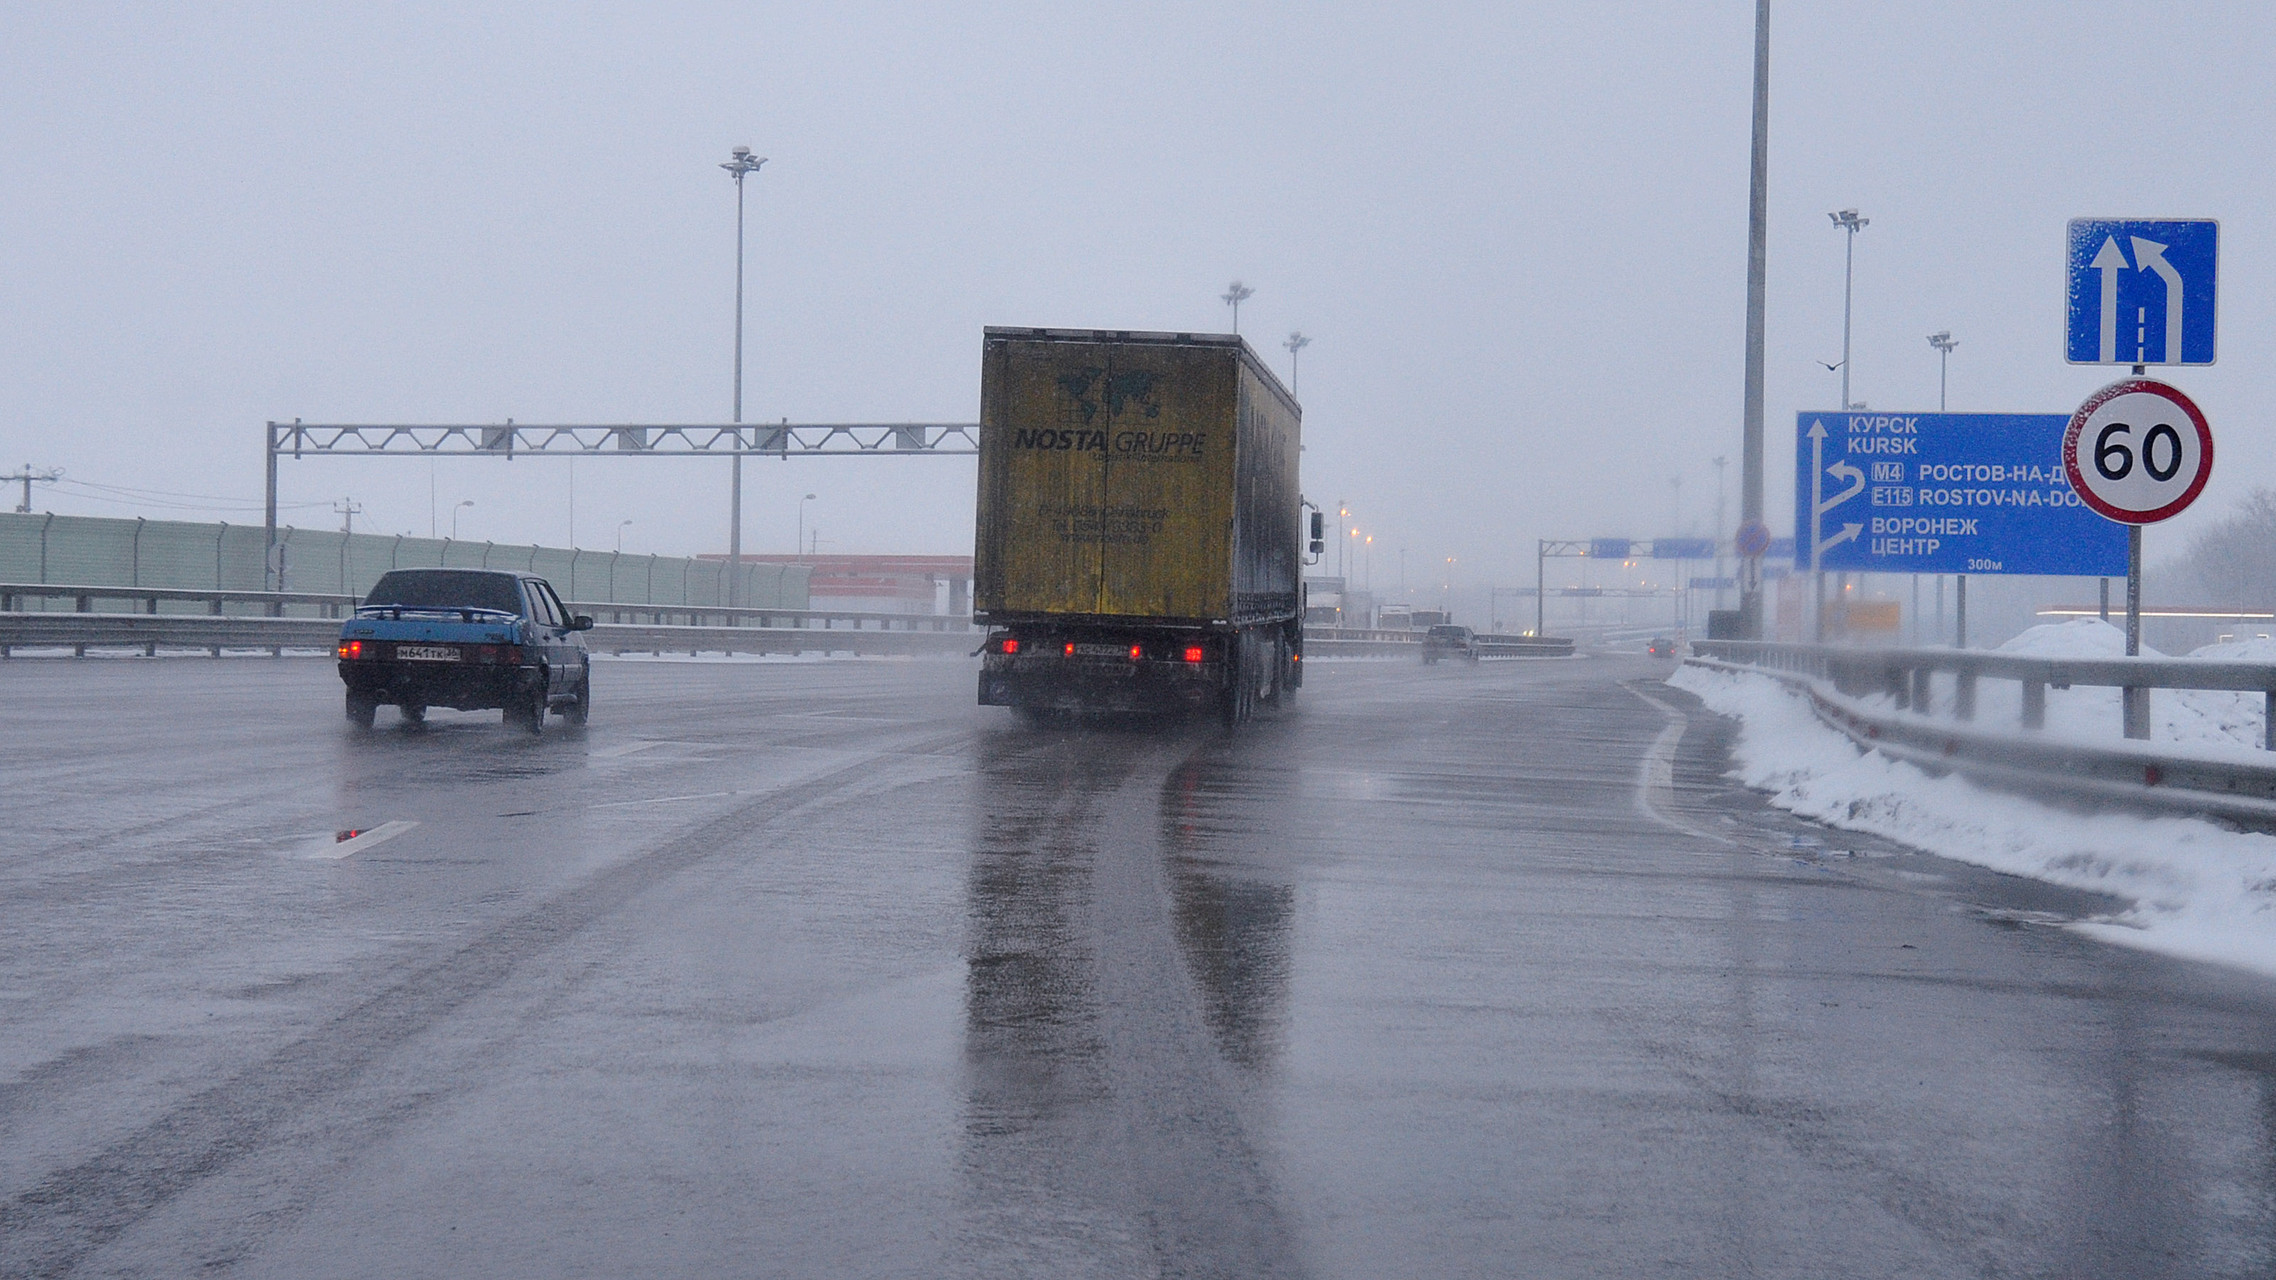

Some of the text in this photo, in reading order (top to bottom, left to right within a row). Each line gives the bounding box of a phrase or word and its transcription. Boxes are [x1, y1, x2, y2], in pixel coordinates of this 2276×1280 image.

[1848, 416, 1918, 435] КУРСК
[1014, 427, 1207, 454] NOSTA GRUPPE
[1848, 437, 1918, 455] KURSK
[2093, 422, 2183, 483] 60
[1919, 464, 2065, 485] РОСТОВ-НА-Д
[1873, 488, 1911, 506] E115
[1919, 489, 2088, 508] ROSTOV-NA-DO
[1871, 517, 1979, 536] ВОРОНЕЖ
[1871, 538, 1941, 557] ЦЕНТР
[1967, 558, 2003, 571] 300м
